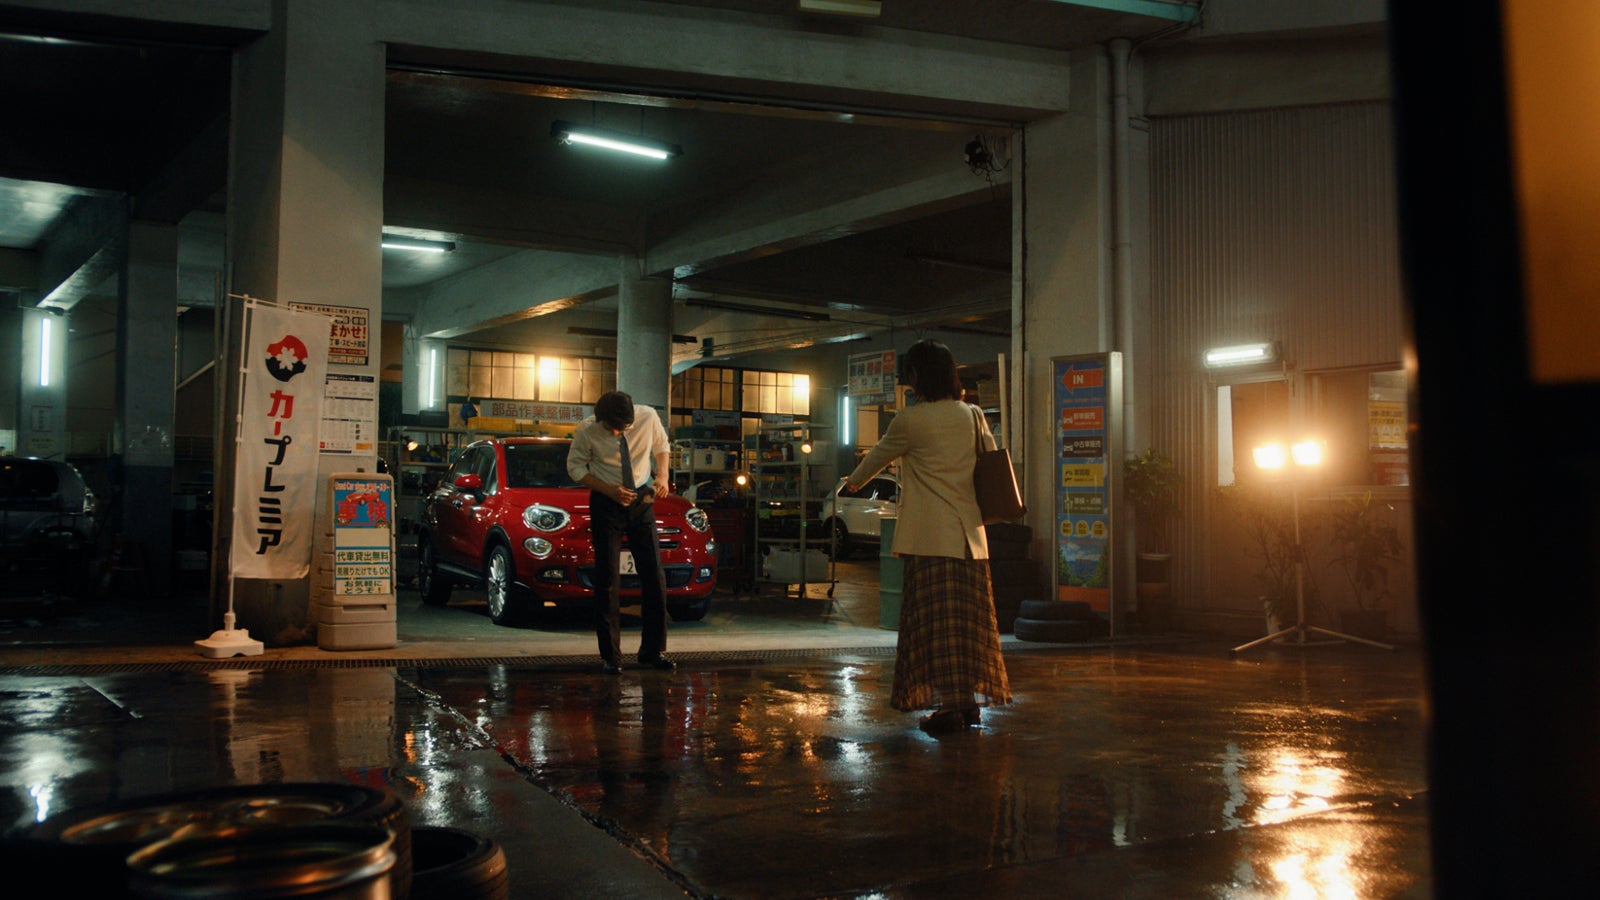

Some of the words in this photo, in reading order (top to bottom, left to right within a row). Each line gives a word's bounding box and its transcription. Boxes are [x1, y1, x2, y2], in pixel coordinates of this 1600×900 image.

[1072, 374, 1084, 385] IN
[491, 402, 584, 420] 部品作業整備場
[1073, 440, 1102, 449] 中古車販売
[255, 389, 294, 555] カープレミア
[337, 551, 389, 561] 代車貸出無料
[337, 567, 378, 576] 見積りだけでも
[379, 566, 390, 575] OK
[344, 580, 382, 588] お気軽に
